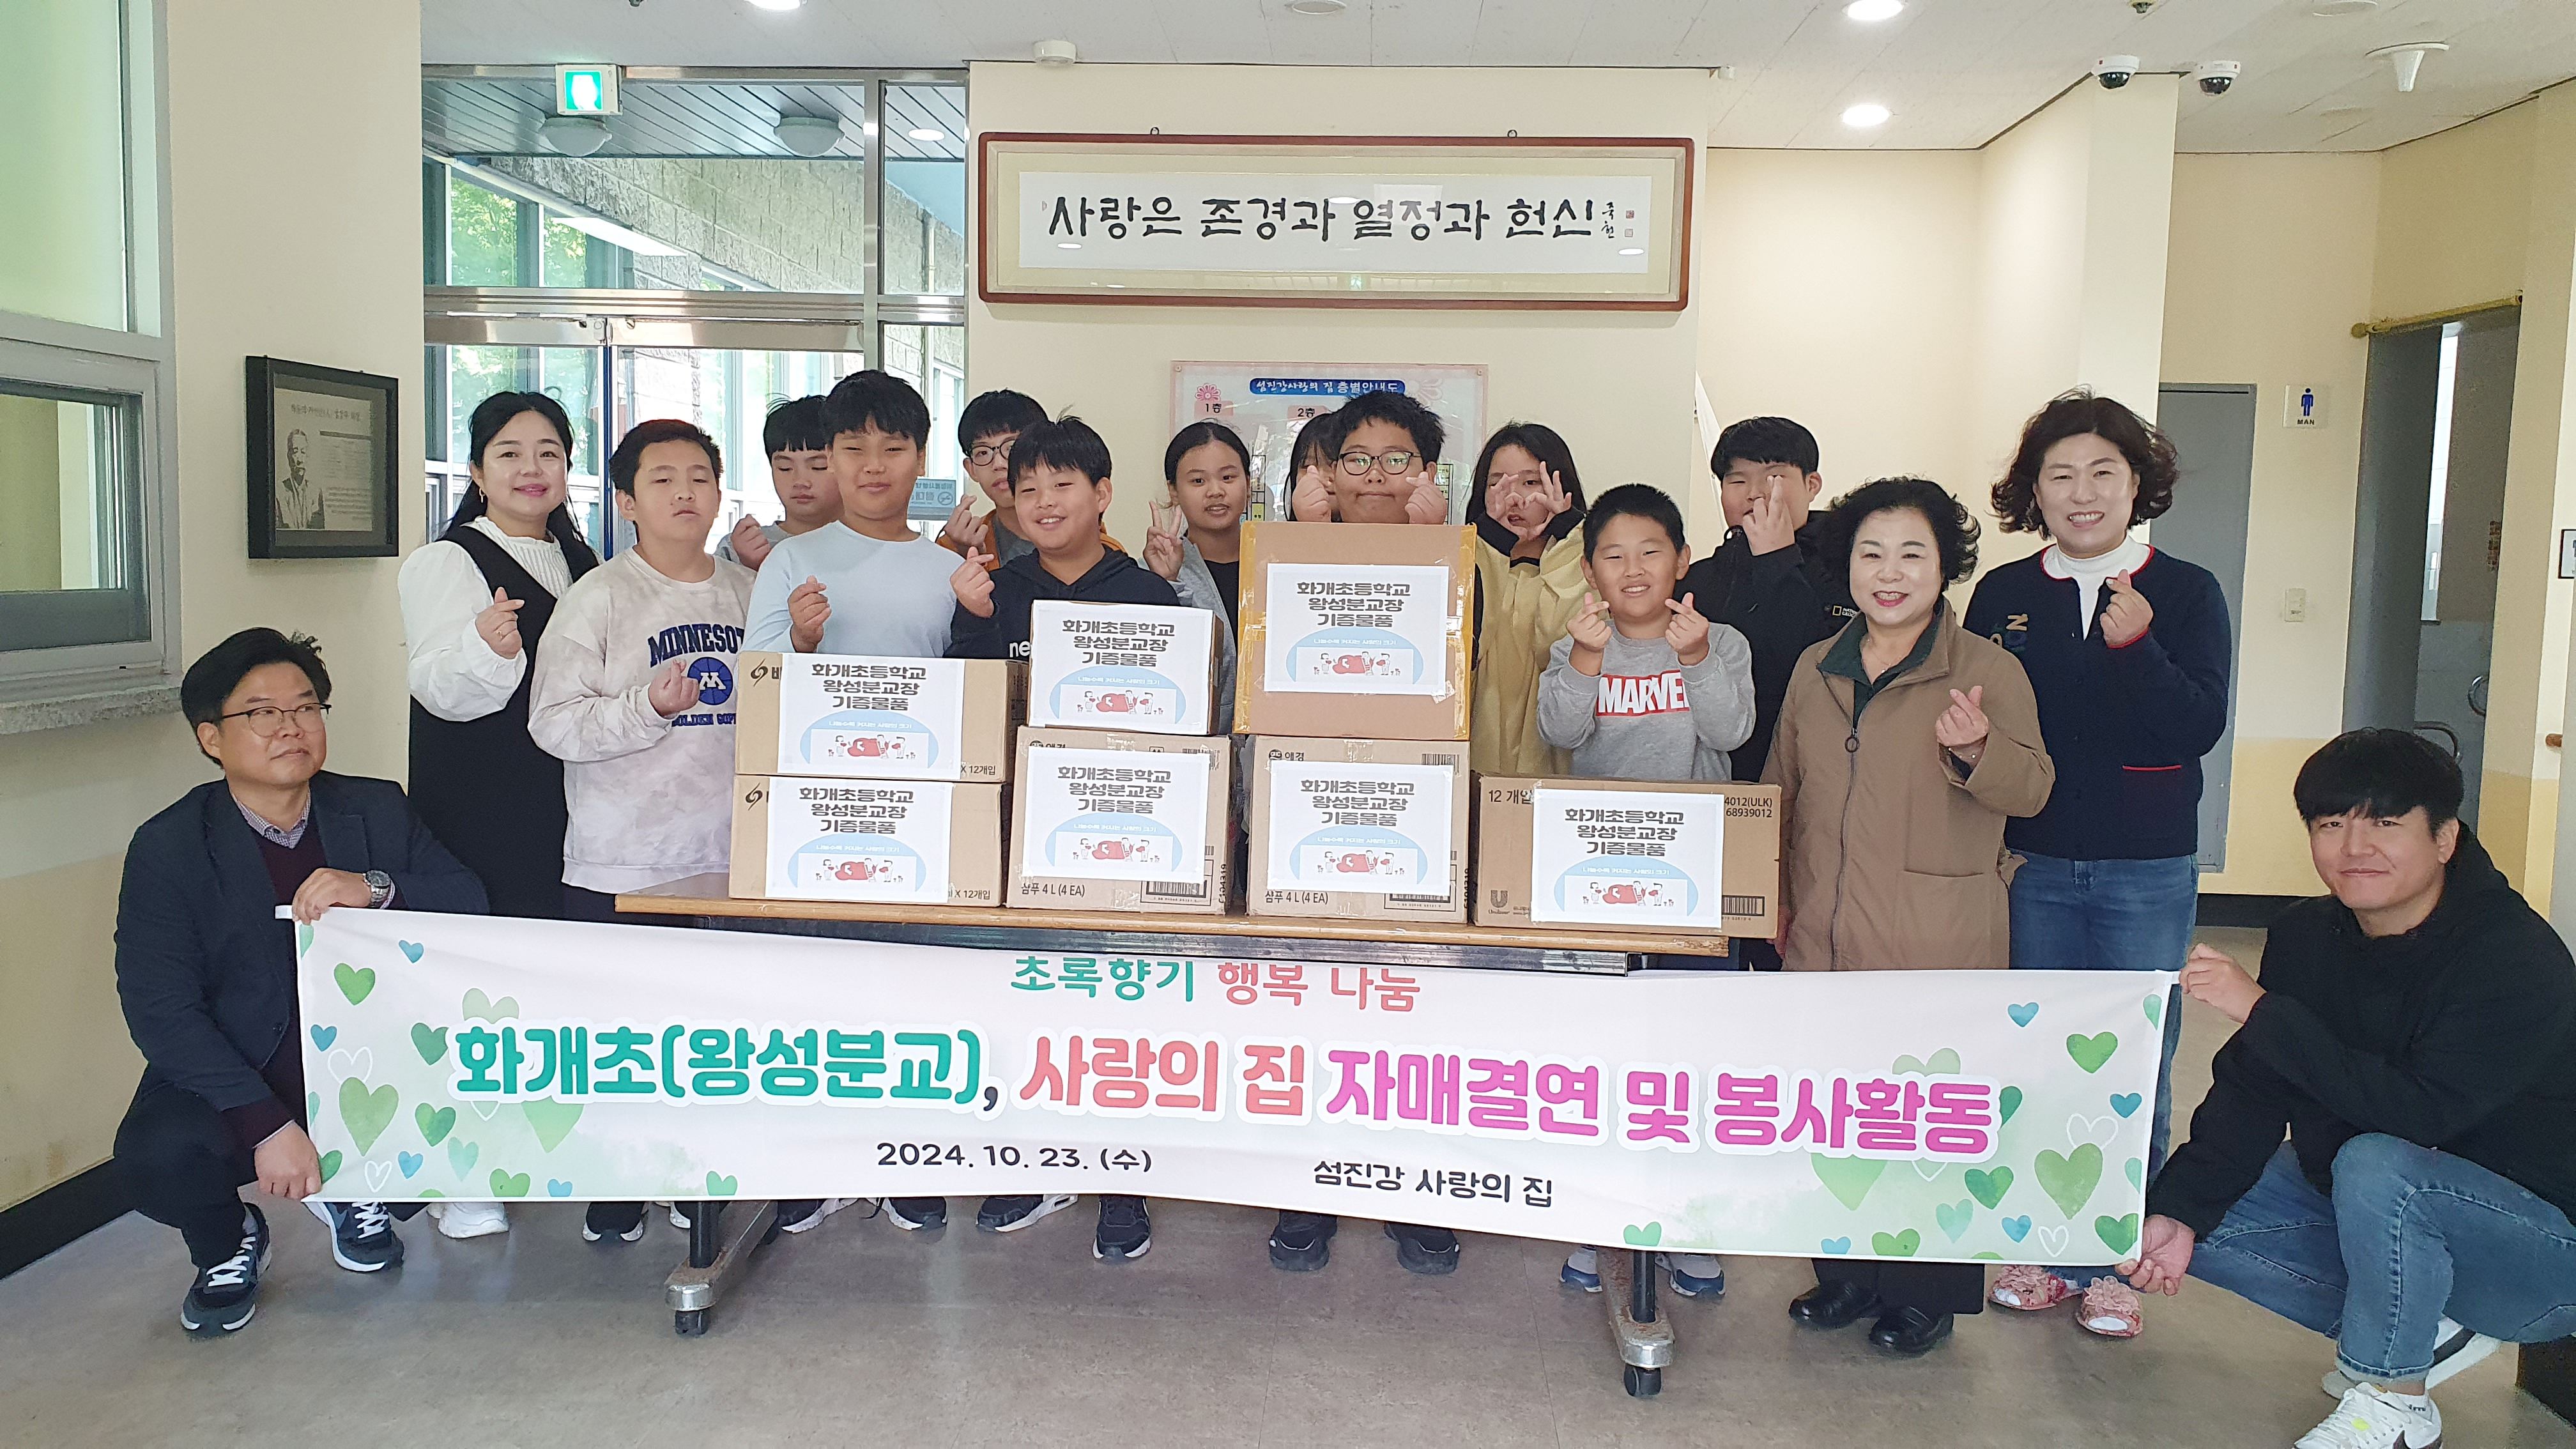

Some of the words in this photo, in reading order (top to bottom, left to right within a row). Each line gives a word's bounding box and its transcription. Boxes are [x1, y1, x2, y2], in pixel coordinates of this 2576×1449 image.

[1049, 197, 1182, 239] 사랑은
[1200, 197, 1335, 241] 존경과
[1354, 199, 1490, 241] 열정과
[1506, 199, 1593, 238] 헌신
[1256, 379, 1318, 392] 섬진강사랑의
[1323, 381, 1333, 392] 집
[1205, 403, 1222, 413] 1층
[1298, 408, 1315, 418] 2층
[1297, 582, 1411, 597] 화개초등학교
[1308, 597, 1404, 612] 왕성분교장
[1317, 613, 1393, 627] 기증물품
[1062, 620, 1175, 637] 화개초등학교
[1009, 641, 1030, 657] ne
[1073, 636, 1169, 652] 왕성분교장
[1082, 652, 1158, 667] 기증물품
[811, 663, 927, 680] 화개초등학교
[700, 672, 726, 691] M
[823, 680, 920, 696] 왕성분교장
[832, 696, 909, 711] 기증물품
[969, 765, 995, 775] 12개입
[1057, 766, 1171, 783] 화개초등학교
[1069, 783, 1165, 799] 왕성분교장
[1301, 779, 1415, 795] 화개초등학교
[799, 788, 914, 804] 화개초등학교
[1312, 795, 1408, 811] 왕성분교장
[1489, 790, 1501, 802] 12
[1506, 789, 1533, 804] 개입
[1724, 797, 1772, 808] 4012(ULK)
[811, 803, 908, 818] 왕성분교장
[1078, 799, 1154, 814] 기증물품
[1726, 808, 1772, 818] 68939012
[1321, 812, 1397, 827] 기증물품
[1565, 808, 1684, 825] 화개초등학교
[820, 819, 896, 834] 기증물품
[1577, 825, 1678, 841] 왕성분교장
[1586, 841, 1666, 857] 기증물품
[963, 890, 990, 900] 12개입
[1021, 883, 1039, 895] 샴푸
[1070, 884, 1085, 898] EA)
[1265, 891, 1284, 903] 샴푸
[1313, 892, 1328, 905] EA)
[1011, 956, 1195, 1002] 초록향기
[1217, 962, 1308, 1006] 행복
[1331, 967, 1420, 1012] 나눔
[454, 1024, 999, 1113] 화개초(왕성분교),
[1020, 1037, 1218, 1112] 사랑의
[1245, 1046, 1303, 1116] 집
[1327, 1050, 1599, 1137] 자매결연
[1627, 1071, 1690, 1143] 및
[1714, 1073, 1992, 1154] 봉사활동
[877, 1142, 974, 1168] 2024.
[983, 1145, 1029, 1169] 10.
[1039, 1147, 1089, 1170] 23.
[1100, 1148, 1152, 1173] (수)
[1314, 1160, 1406, 1191] 섬진강
[1415, 1169, 1510, 1203] 사랑의
[1522, 1177, 1552, 1208] 집
